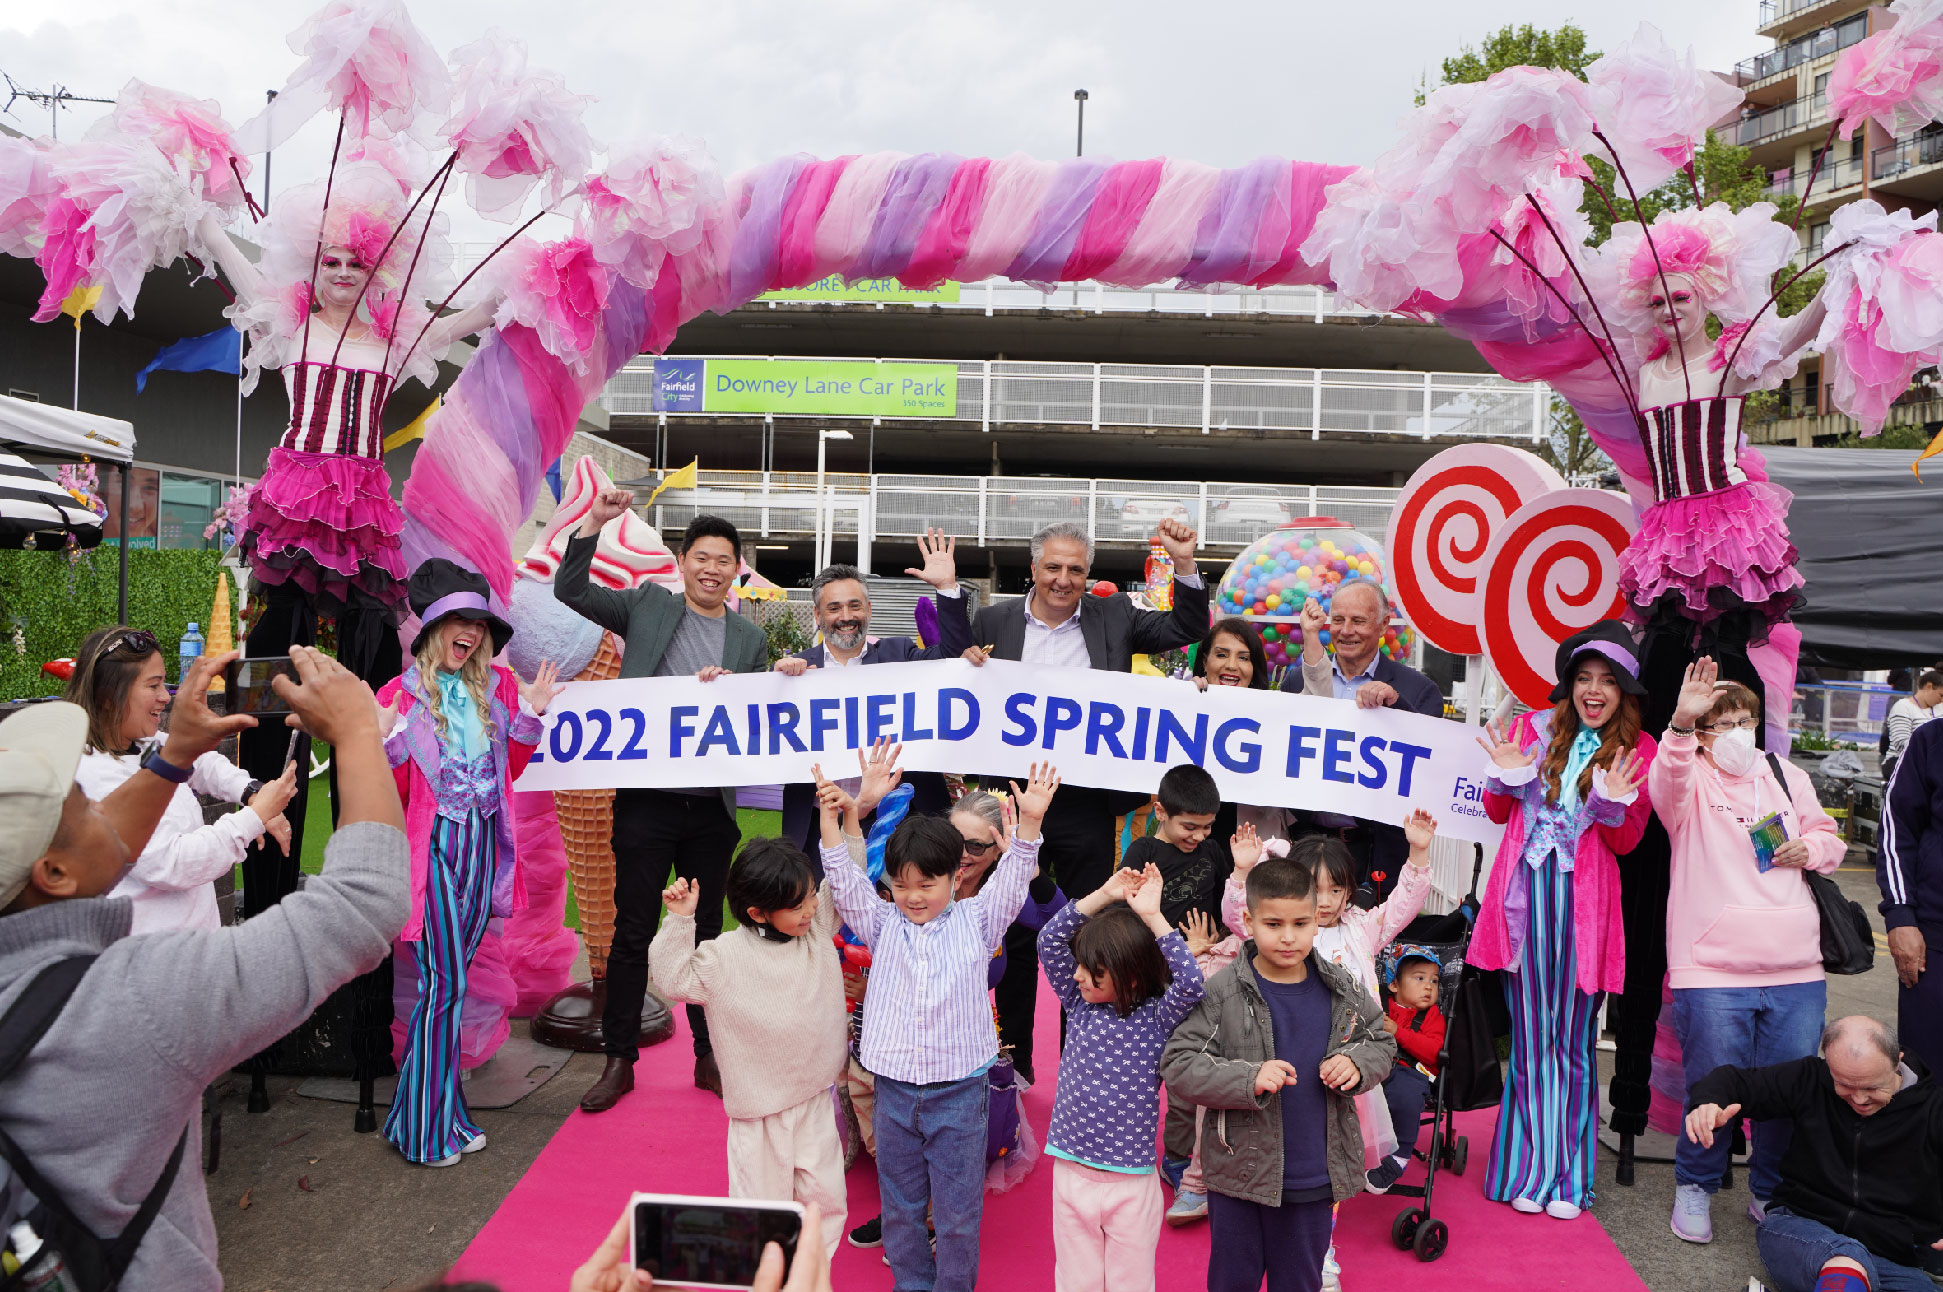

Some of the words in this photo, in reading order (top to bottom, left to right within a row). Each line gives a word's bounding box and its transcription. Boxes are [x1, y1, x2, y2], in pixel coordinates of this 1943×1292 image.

[856, 279, 892, 293] CAR
[661, 381, 696, 391] Fairfield
[717, 374, 798, 399] Downey
[805, 376, 852, 395] Lane
[858, 377, 894, 395] Car
[902, 378, 946, 397] Park
[661, 392, 678, 403] City
[918, 399, 945, 409] Spaces
[529, 707, 648, 763] 022
[669, 688, 981, 758] FAIRFIELD
[1001, 692, 1262, 774] SPRING
[1285, 724, 1433, 798] FEST
[1453, 776, 1484, 803] Fai
